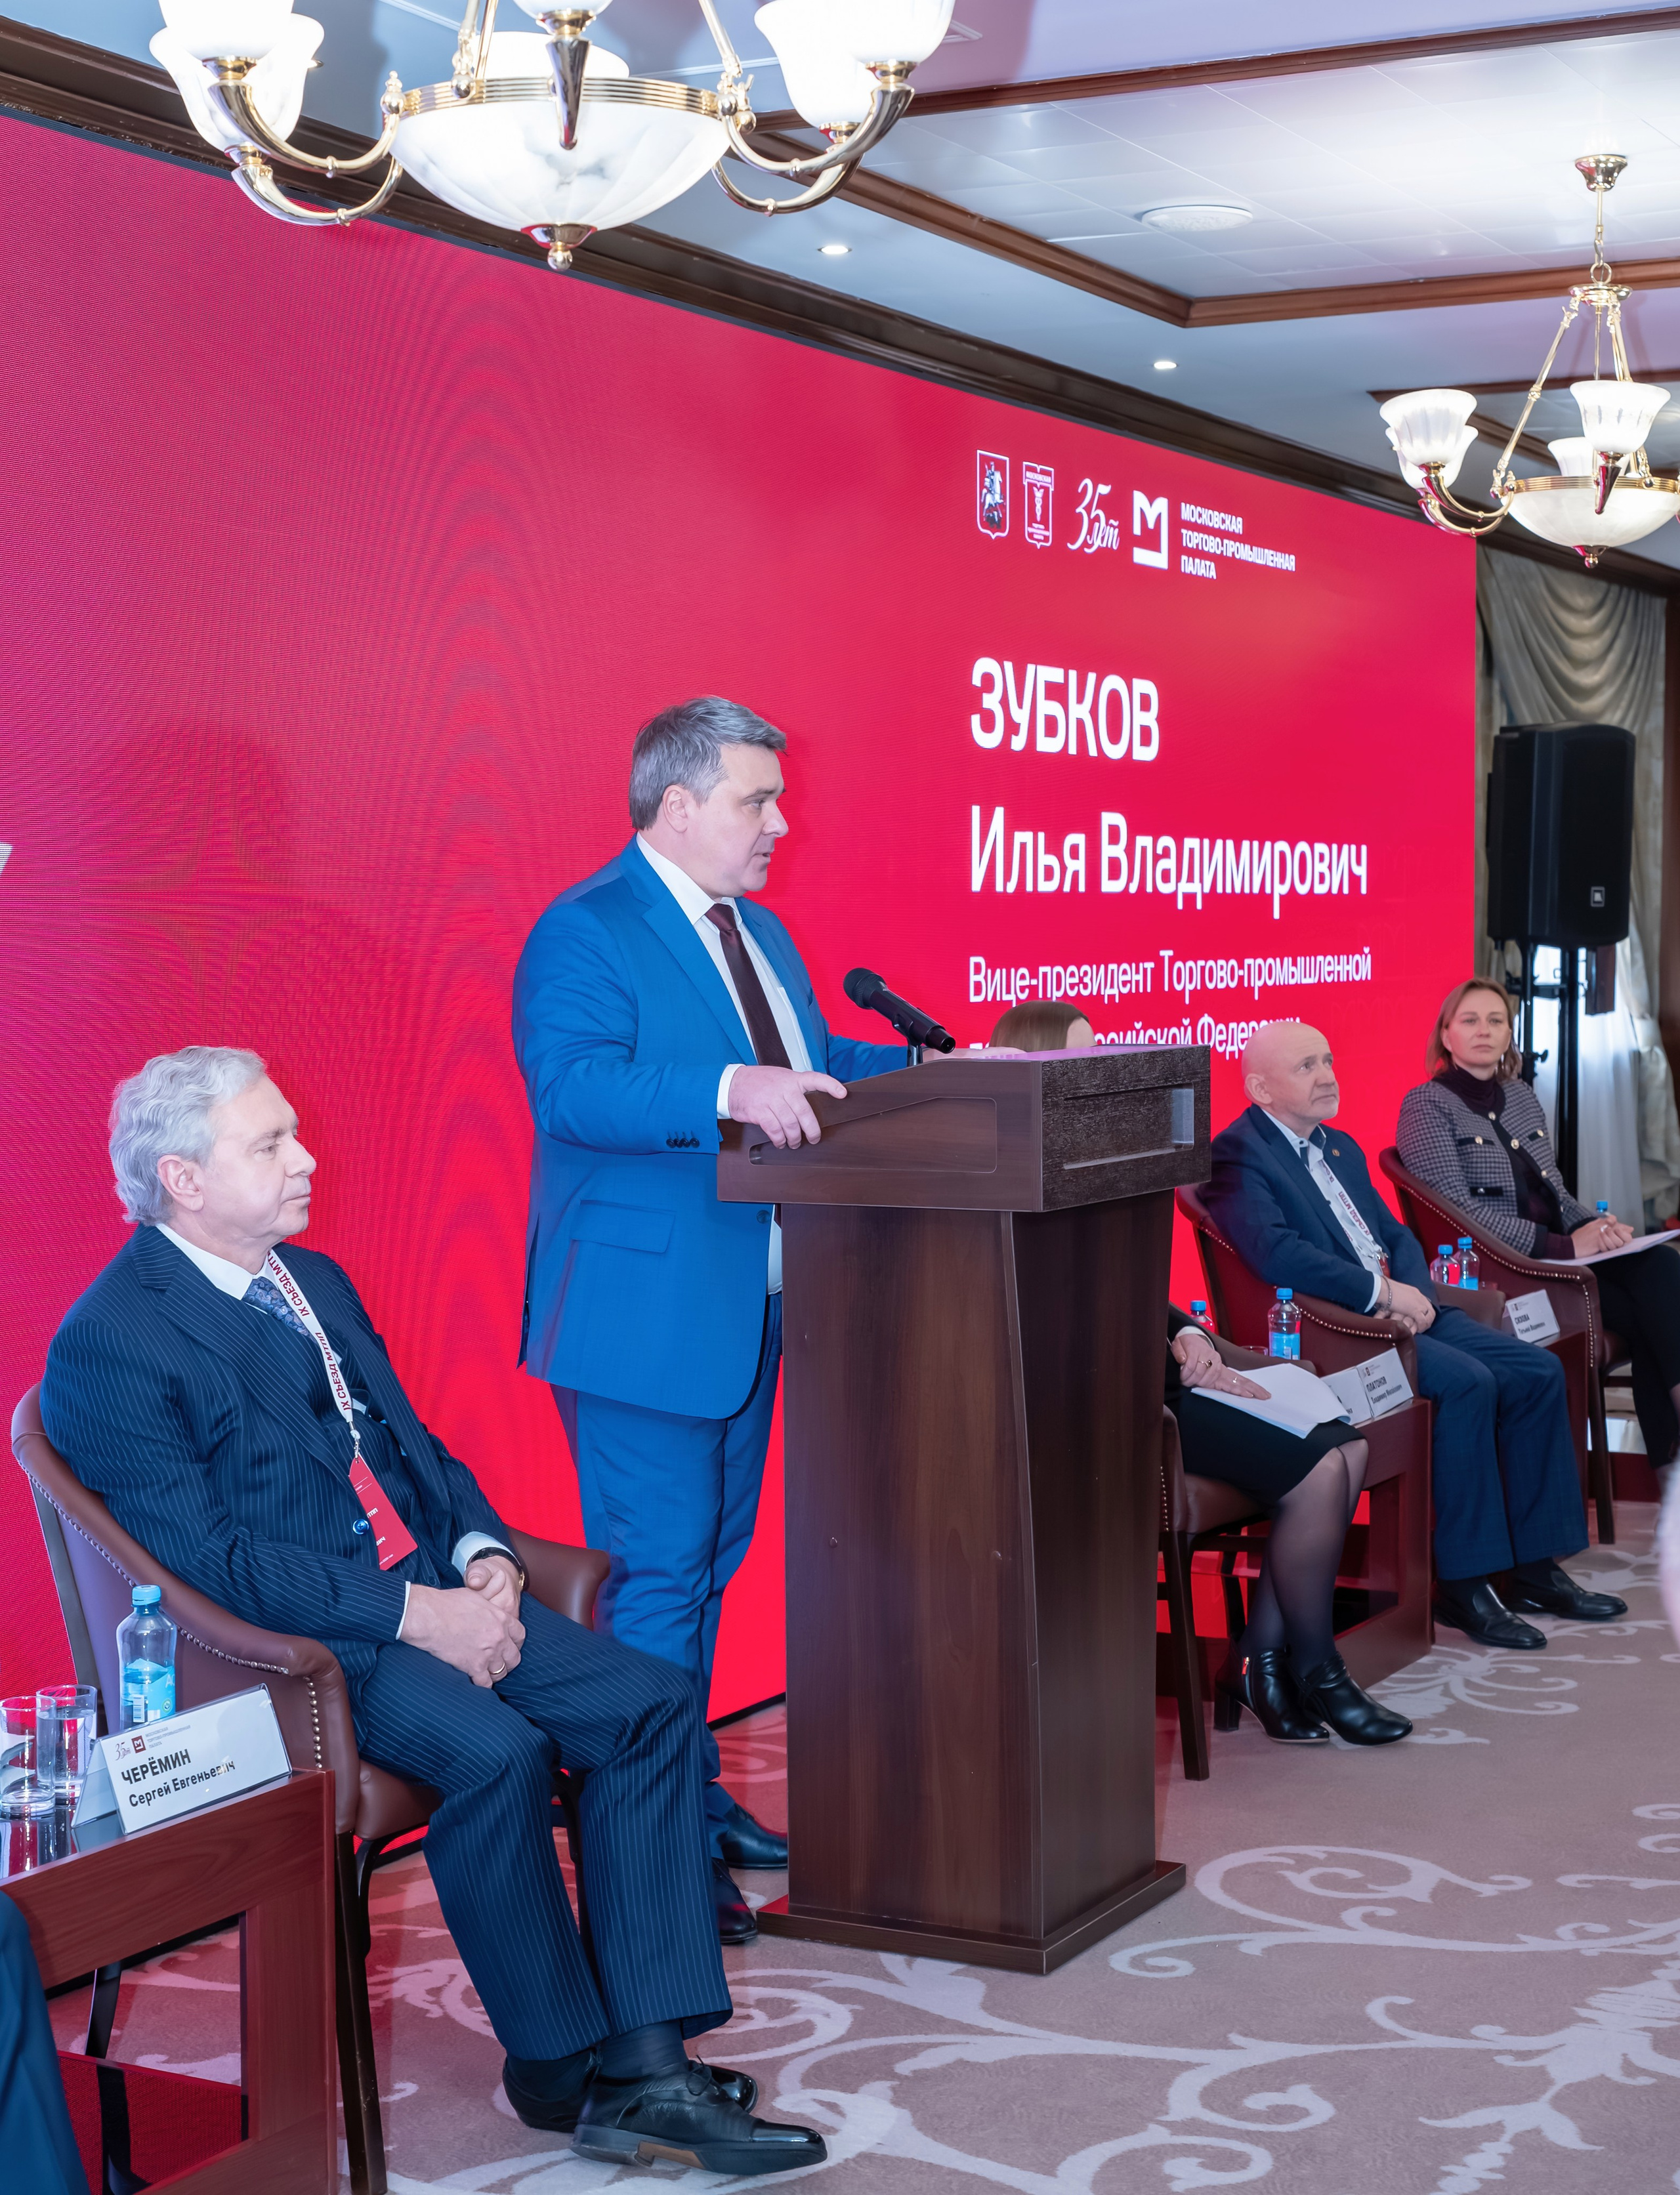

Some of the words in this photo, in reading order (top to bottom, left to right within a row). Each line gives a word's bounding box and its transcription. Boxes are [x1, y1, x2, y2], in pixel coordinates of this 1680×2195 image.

[1067, 478, 1112, 554] 35
[1181, 502, 1243, 535] МОСКОВСКАЯ
[1181, 528, 1296, 572] ТОРГОВО-ПРОМЫШЛЕННАЯ
[1181, 554, 1217, 580] ПАЛАТА
[971, 657, 1160, 762] ЗУБКОВ
[971, 805, 1086, 894] Илья
[1100, 812, 1368, 920] Владимирович
[969, 955, 1155, 1008] Вице-президент
[1159, 946, 1372, 1005] Торгово-промышленной
[278, 1272, 303, 1306] СЪЕЗД
[298, 1306, 310, 1316] IX
[315, 1332, 333, 1361] МТПП
[329, 1364, 346, 1399] СЪЕЗД
[340, 1400, 352, 1411] IX
[121, 1749, 192, 1785] ЧЕРЁМИН
[129, 1782, 171, 1807] Сергей
[171, 1760, 236, 1792] Евгеньевич
